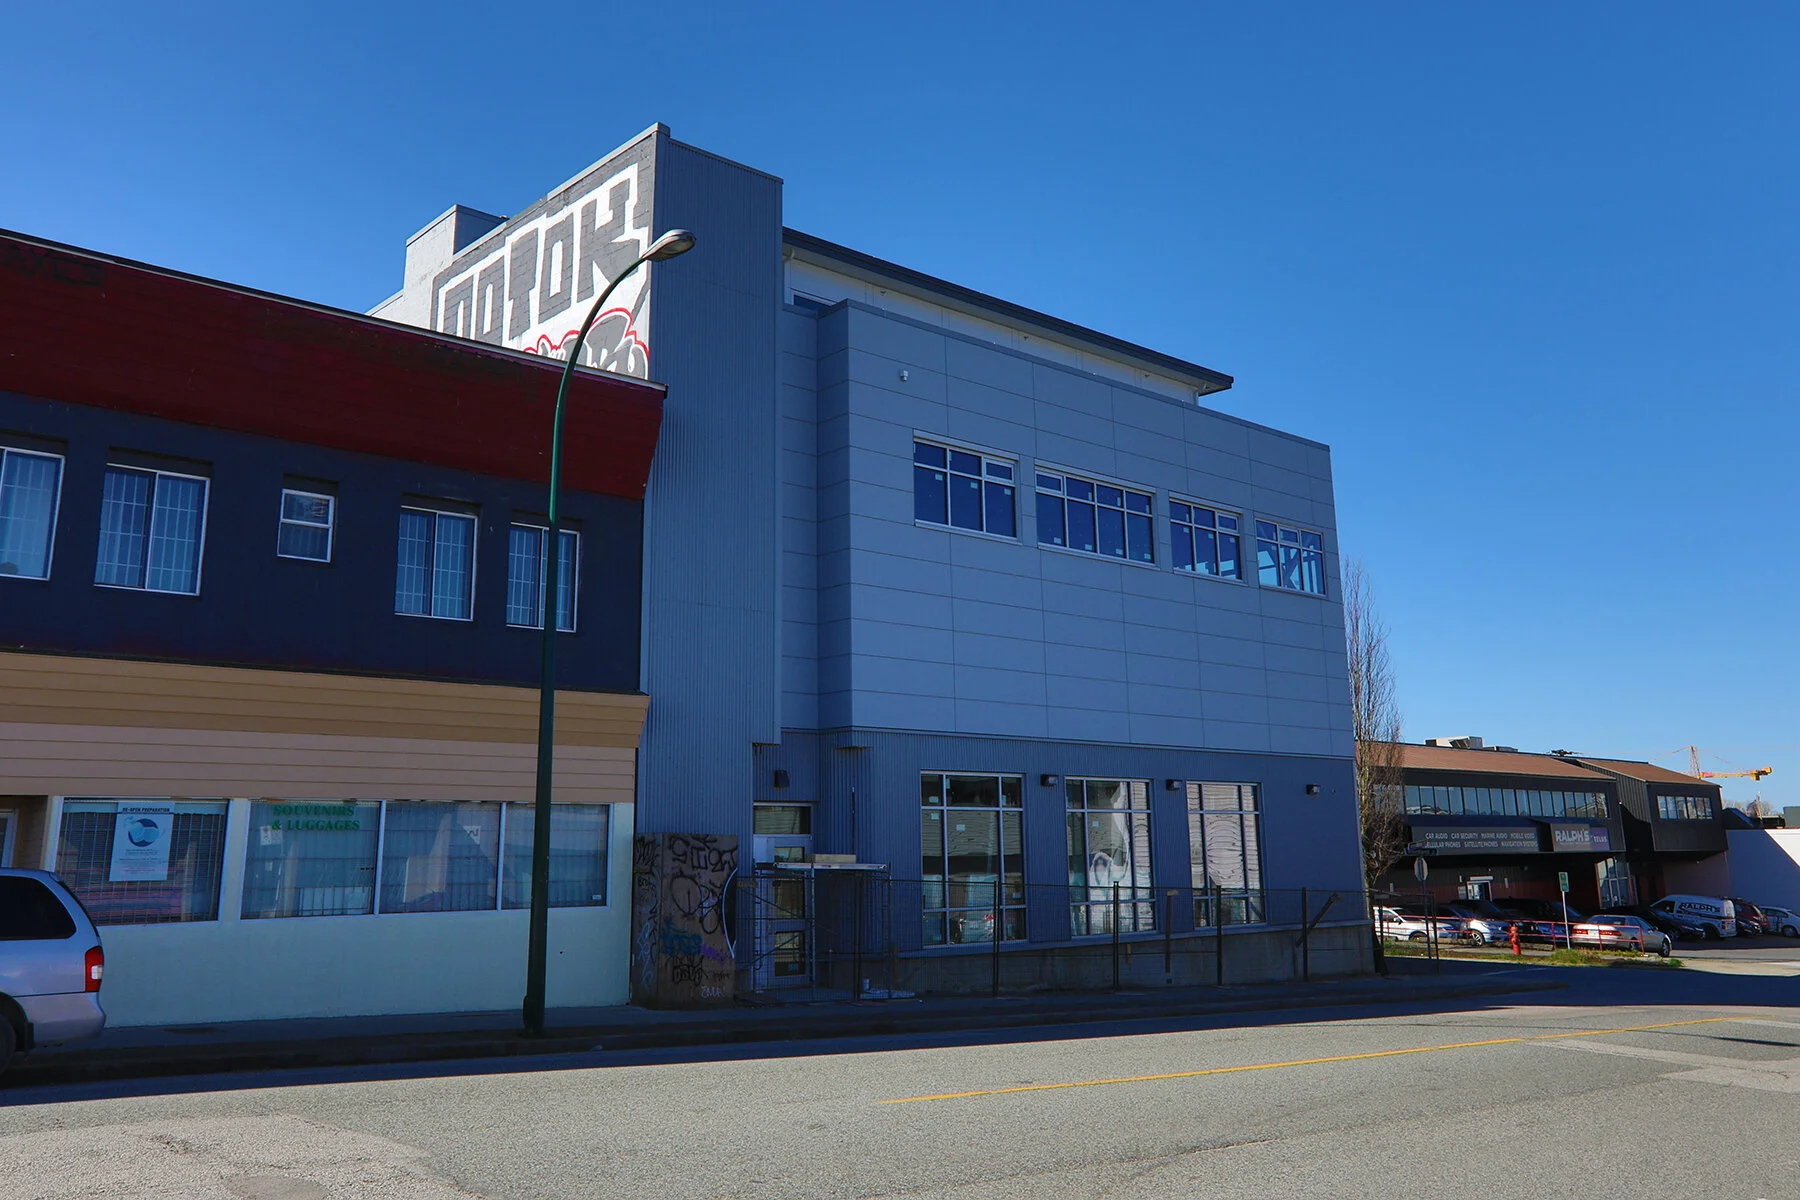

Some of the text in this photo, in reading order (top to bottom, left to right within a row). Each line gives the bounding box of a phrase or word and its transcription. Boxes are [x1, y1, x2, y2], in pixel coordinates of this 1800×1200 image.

[272, 805, 355, 816] SOUVENIRS
[271, 819, 360, 831] & LUGGAGES
[1555, 829, 1590, 842] RALPH'S
